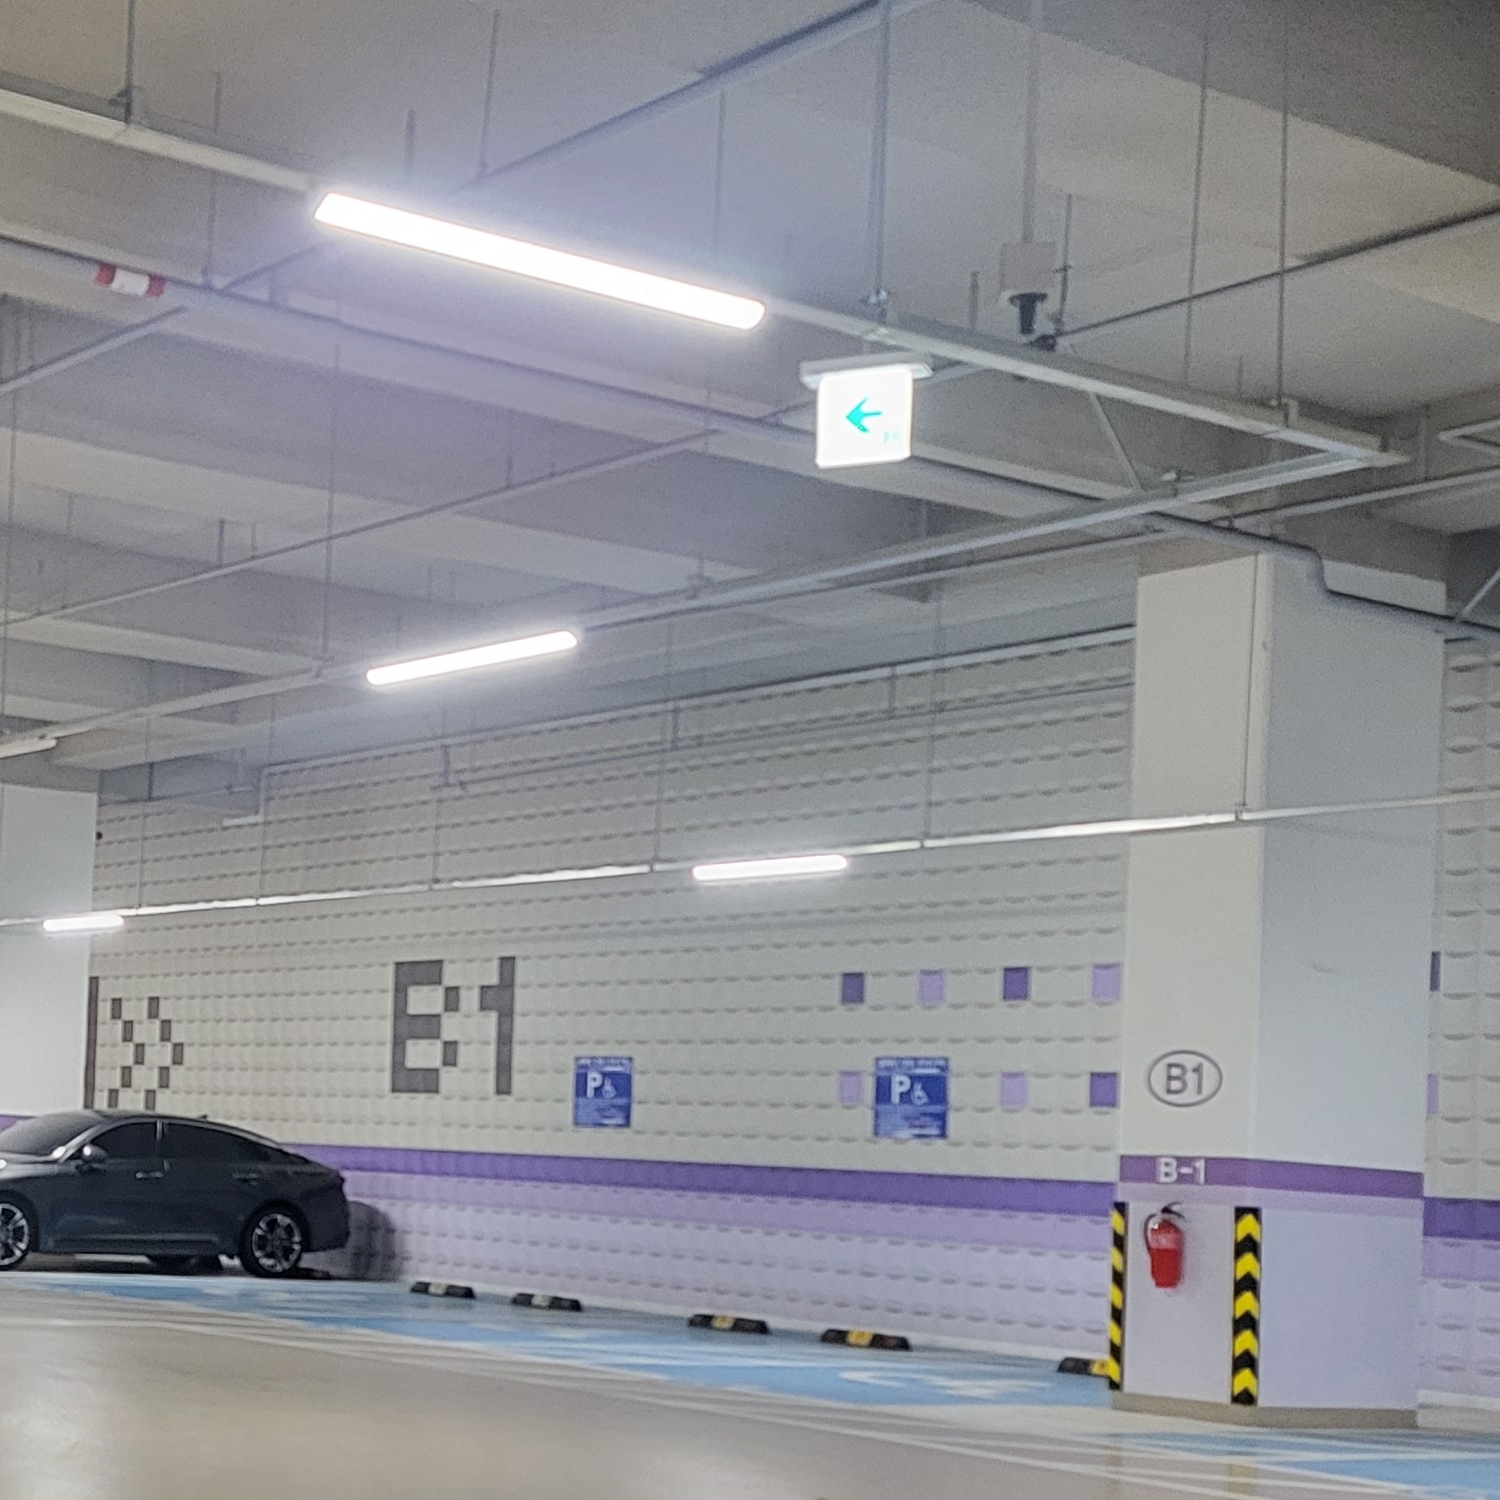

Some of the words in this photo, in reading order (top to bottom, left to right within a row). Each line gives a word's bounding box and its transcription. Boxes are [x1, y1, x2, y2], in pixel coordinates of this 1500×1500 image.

[391, 956, 515, 1095] B1
[1166, 1062, 1204, 1096] B1
[1158, 1158, 1205, 1186] B-1
